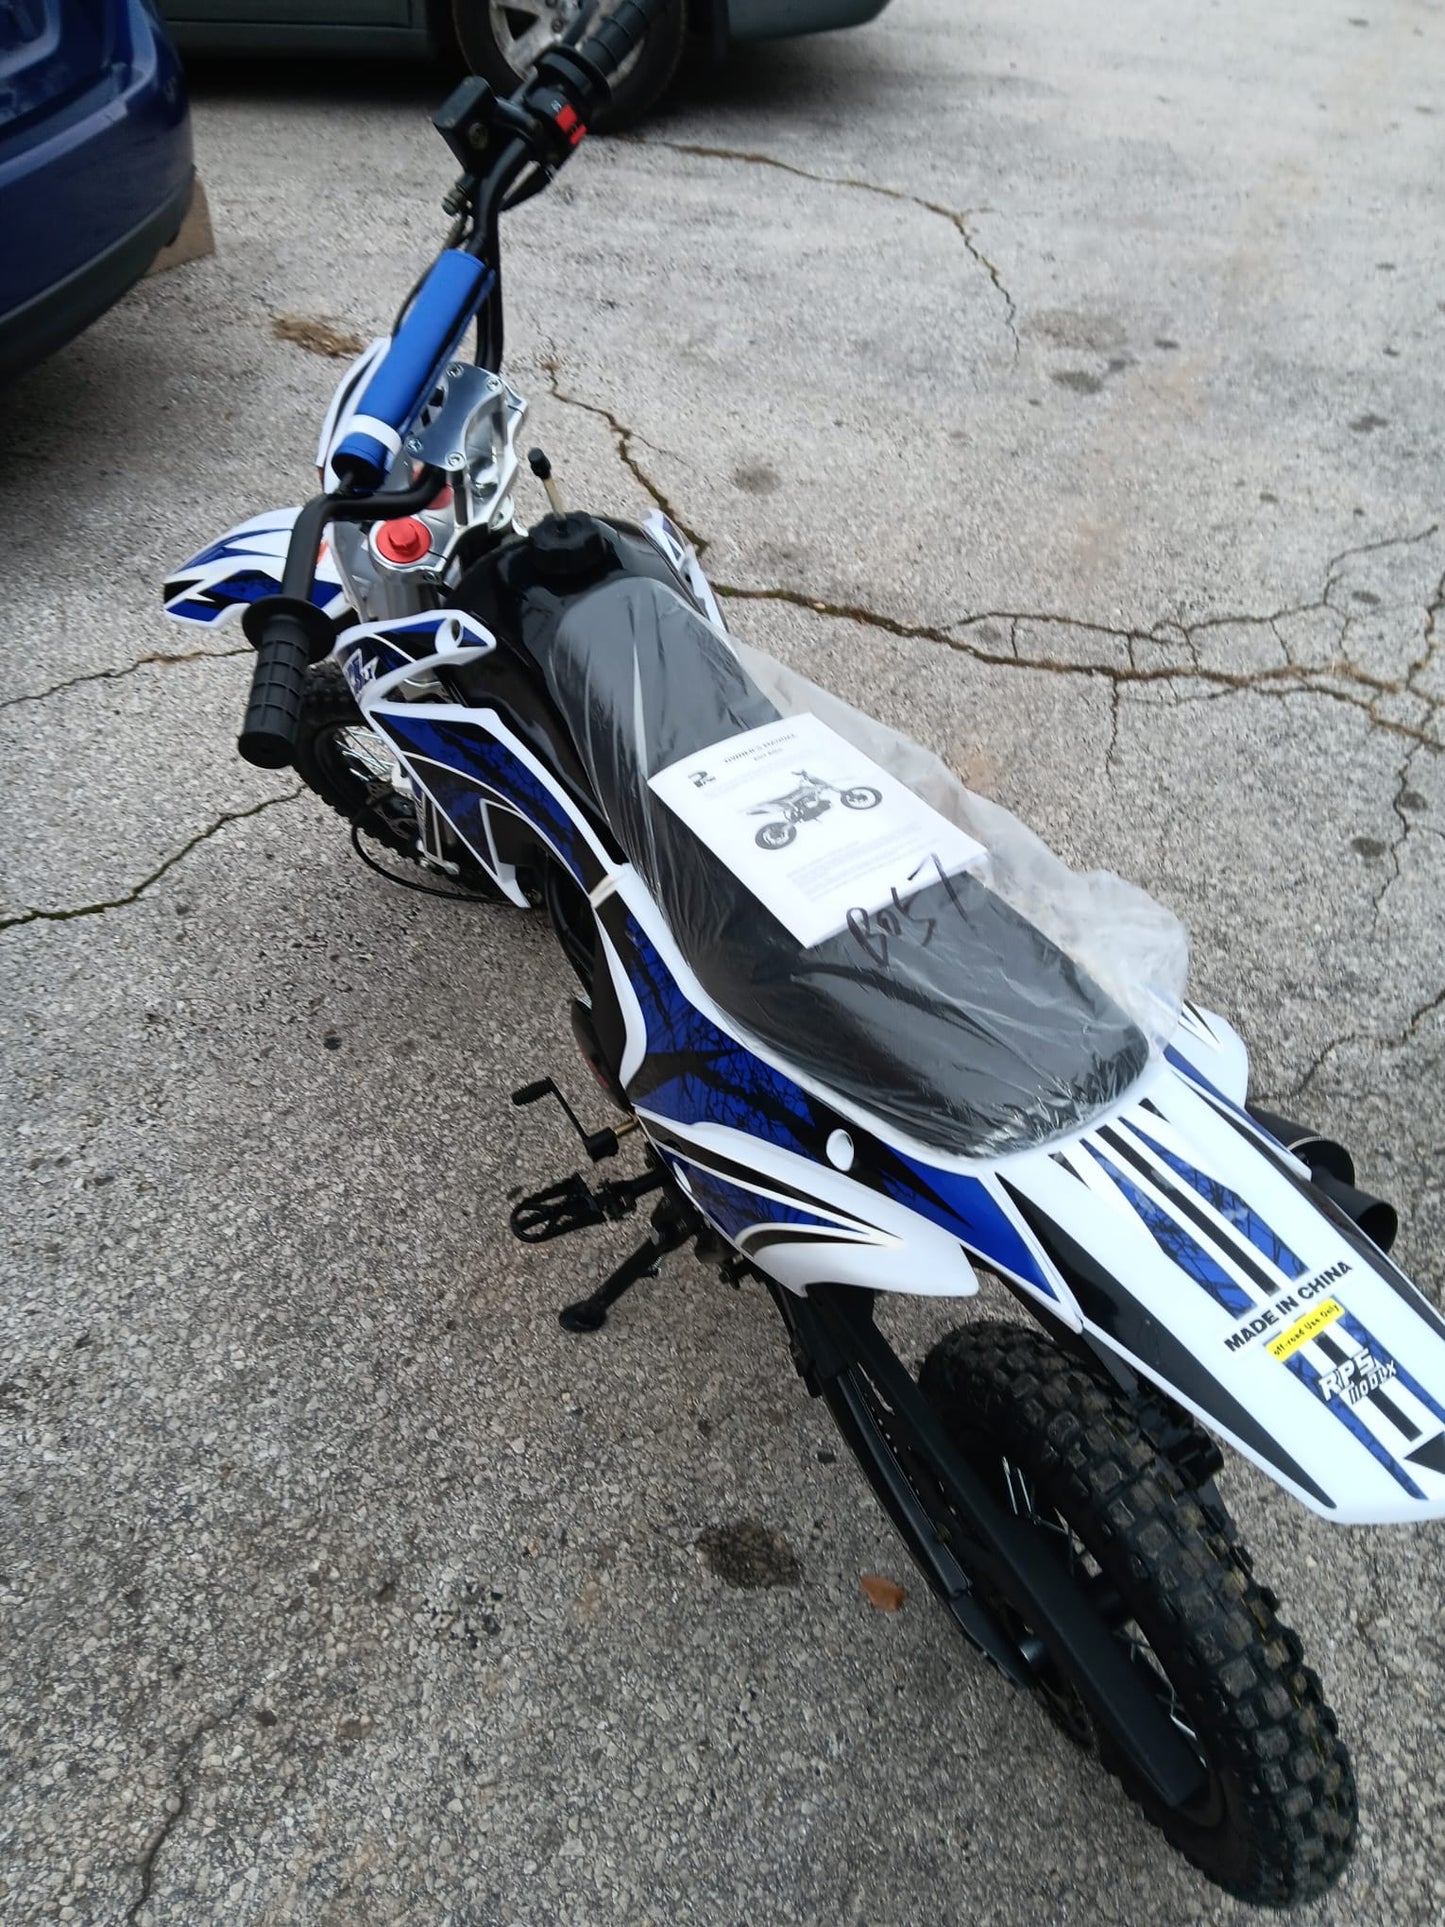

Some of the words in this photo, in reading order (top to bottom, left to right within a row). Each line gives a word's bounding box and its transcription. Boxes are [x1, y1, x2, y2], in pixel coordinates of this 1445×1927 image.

[1224, 1310, 1279, 1352] MADE
[1275, 1295, 1300, 1316] IN
[1297, 1261, 1353, 1300] CHINA
[1318, 1347, 1376, 1402] RPS
